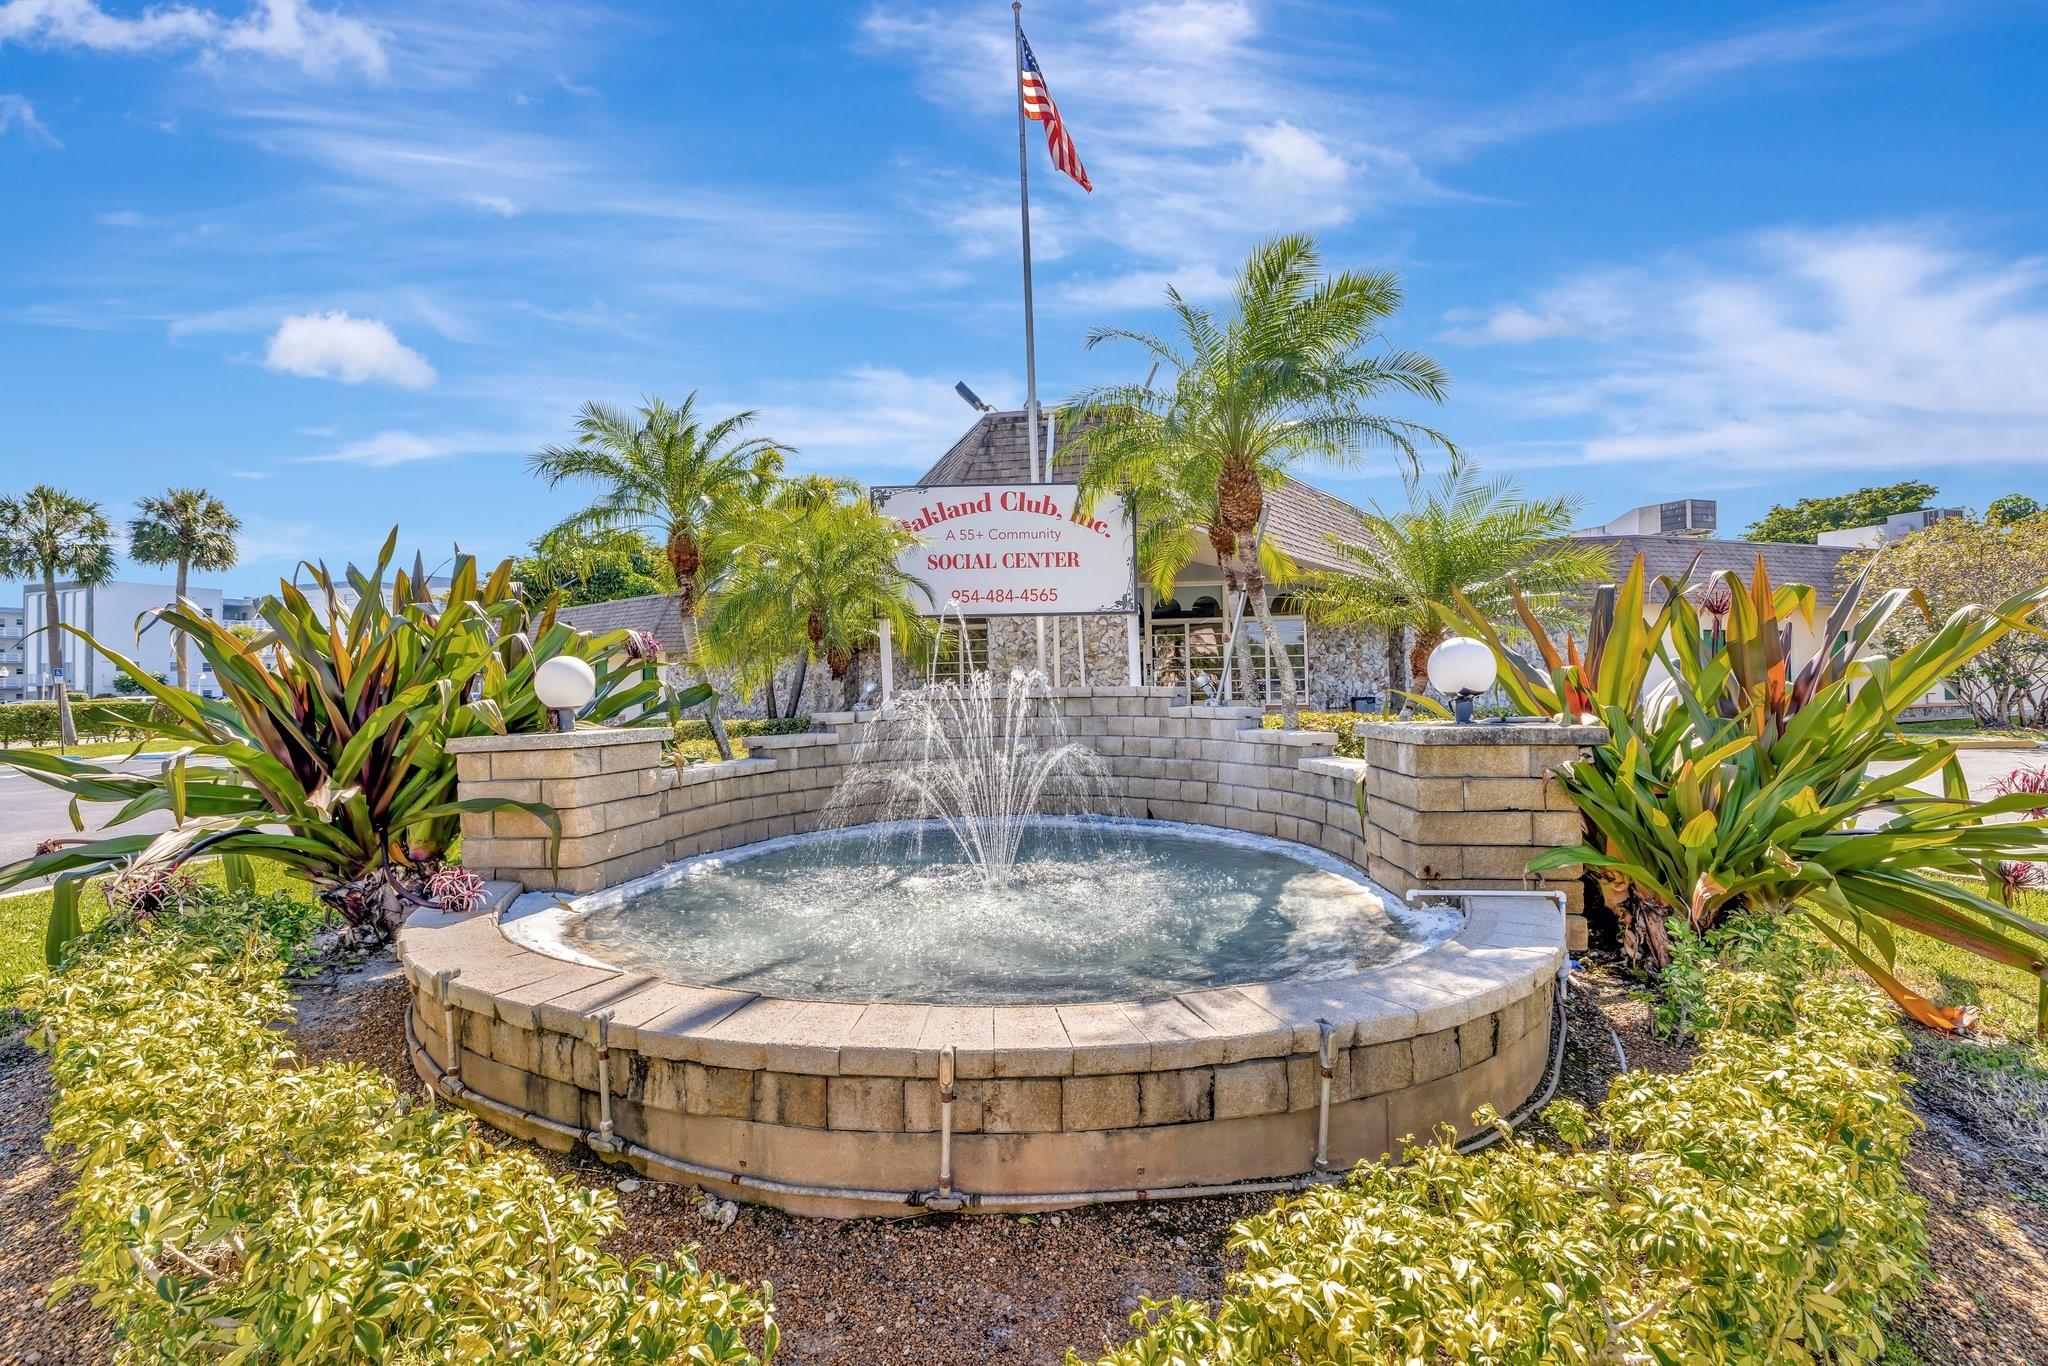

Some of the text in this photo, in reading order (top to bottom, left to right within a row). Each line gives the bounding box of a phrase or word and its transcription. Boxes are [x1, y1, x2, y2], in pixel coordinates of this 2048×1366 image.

[1000, 491, 1062, 520] Club,
[946, 528, 1061, 542] A 55+ Community
[928, 551, 1080, 570] SOCIAL CENTER
[951, 588, 1058, 603] 954-484-4565
